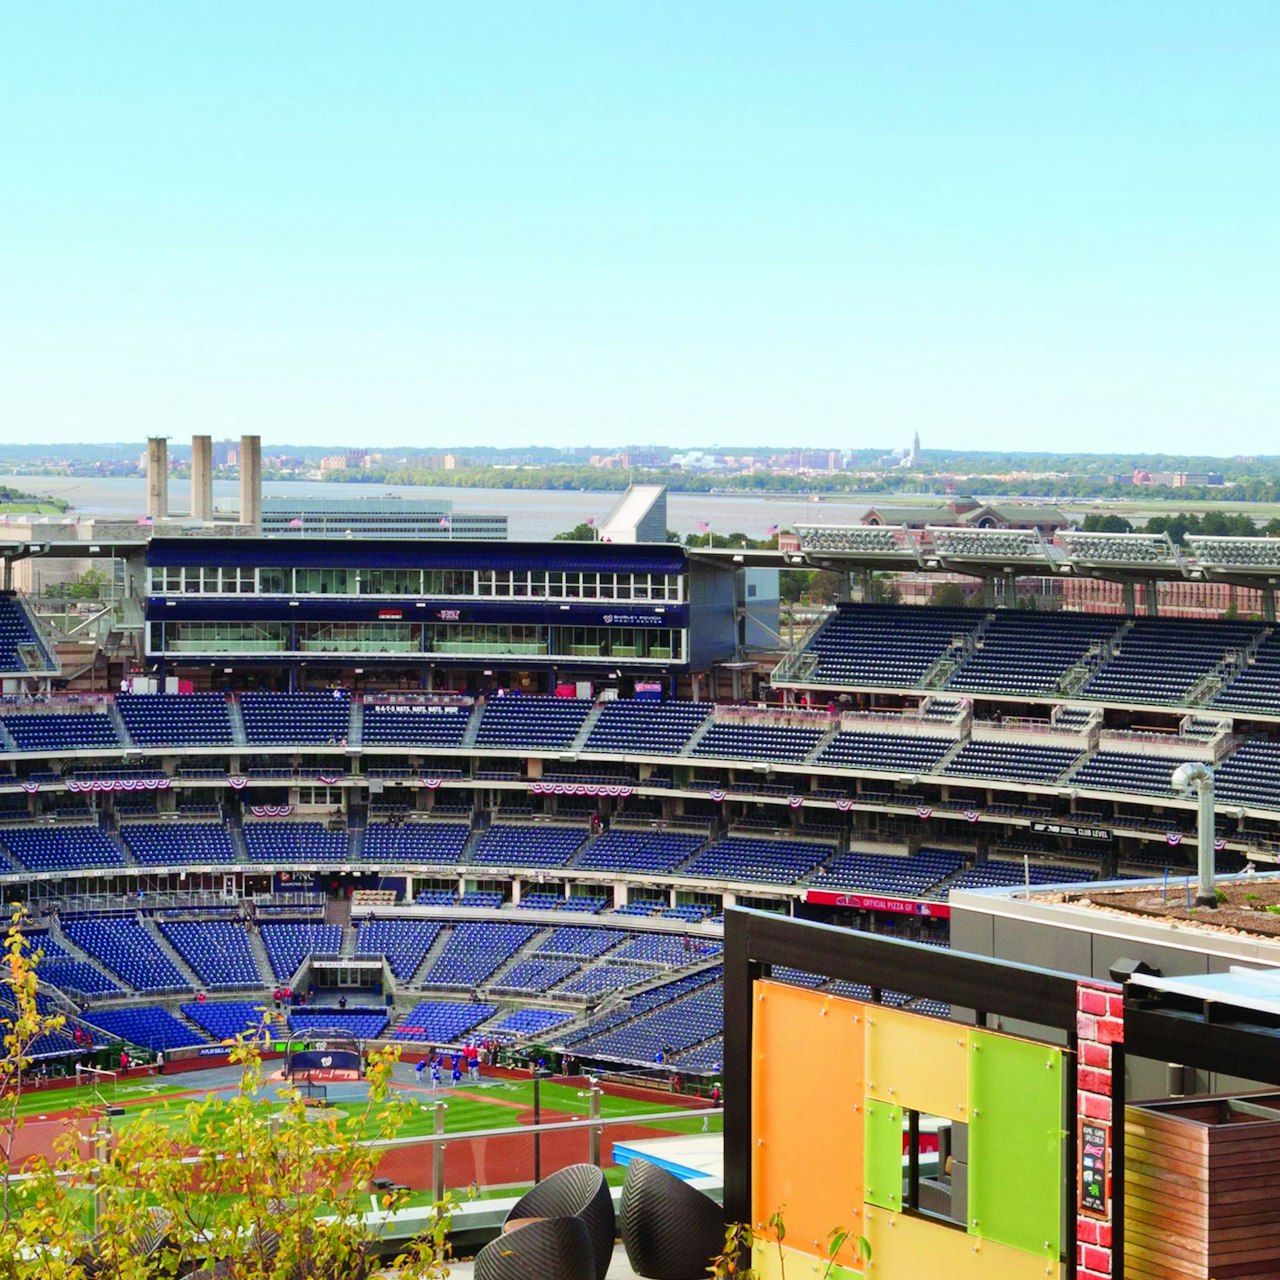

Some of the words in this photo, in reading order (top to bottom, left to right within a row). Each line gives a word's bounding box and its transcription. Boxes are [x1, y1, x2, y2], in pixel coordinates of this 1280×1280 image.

[1077, 828, 1091, 836] CLUB
[1092, 830, 1109, 839] LEVEL
[292, 871, 315, 881] PNC
[863, 899, 886, 908] OFFICIAL
[887, 901, 904, 910] PIZZA
